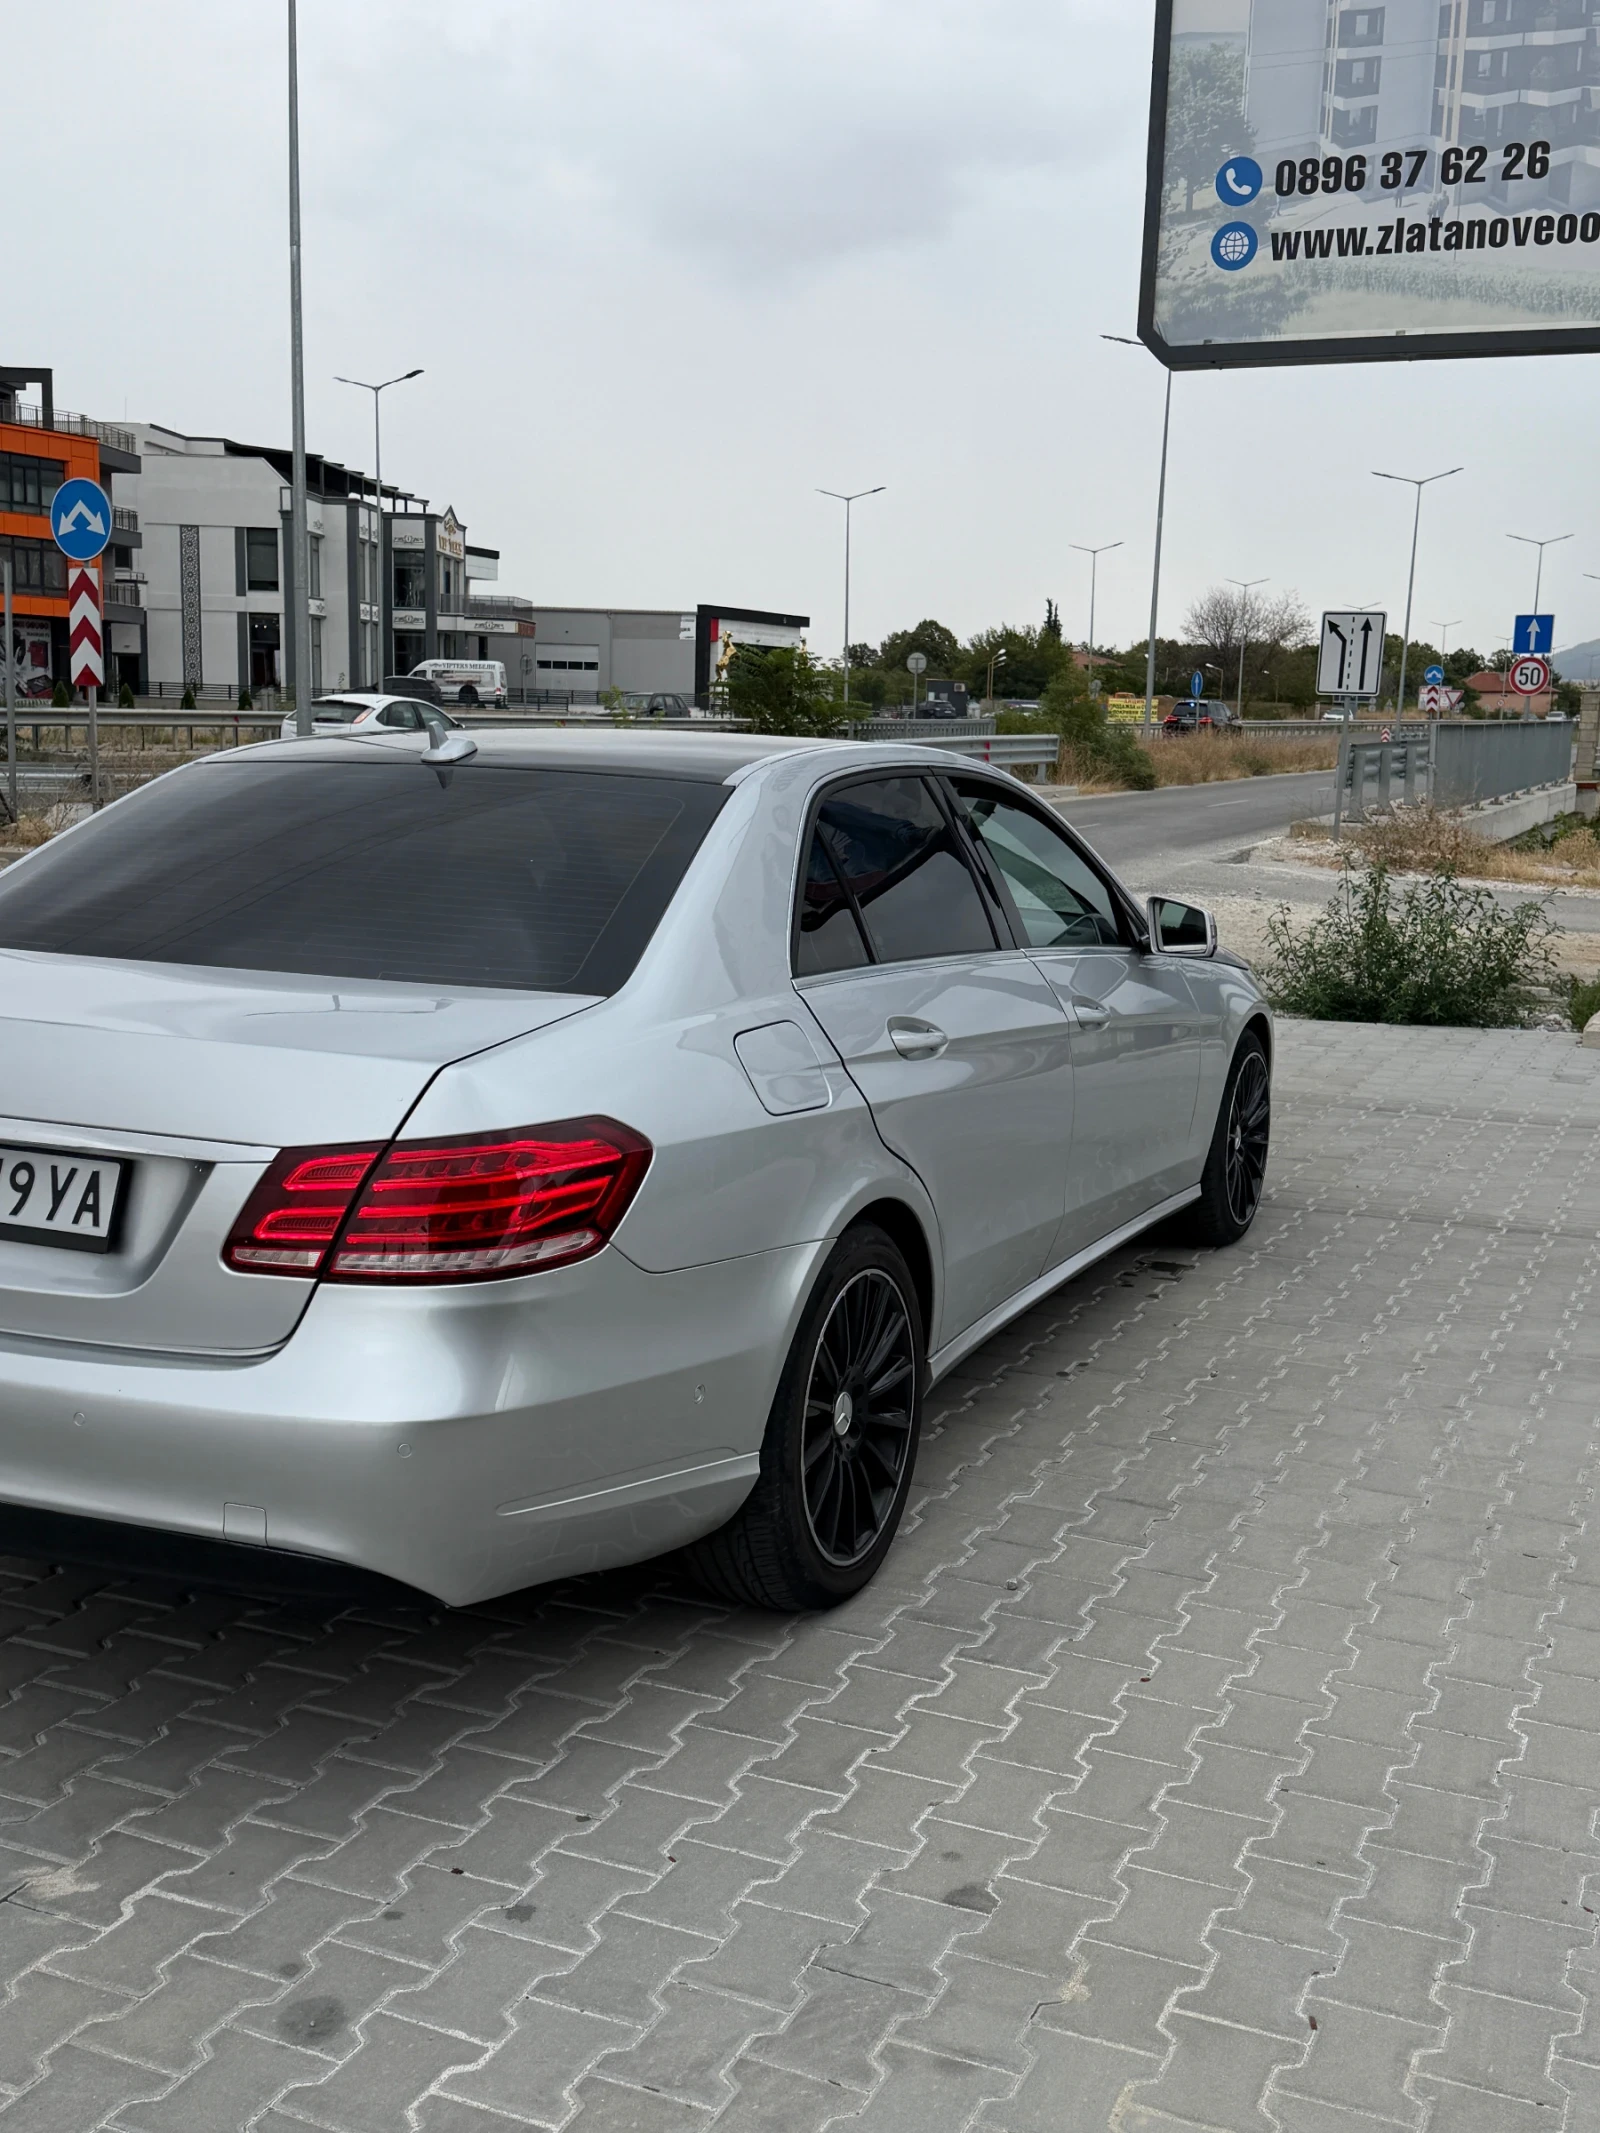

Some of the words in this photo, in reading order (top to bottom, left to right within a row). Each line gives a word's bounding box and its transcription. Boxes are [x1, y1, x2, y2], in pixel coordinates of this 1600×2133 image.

[1274, 155, 1367, 197] 0896
[1380, 150, 1428, 190] 37
[1440, 145, 1488, 186] 62
[1501, 140, 1551, 181] 26
[1271, 212, 1600, 261] www.zlatanoveoo
[1518, 666, 1541, 686] 50
